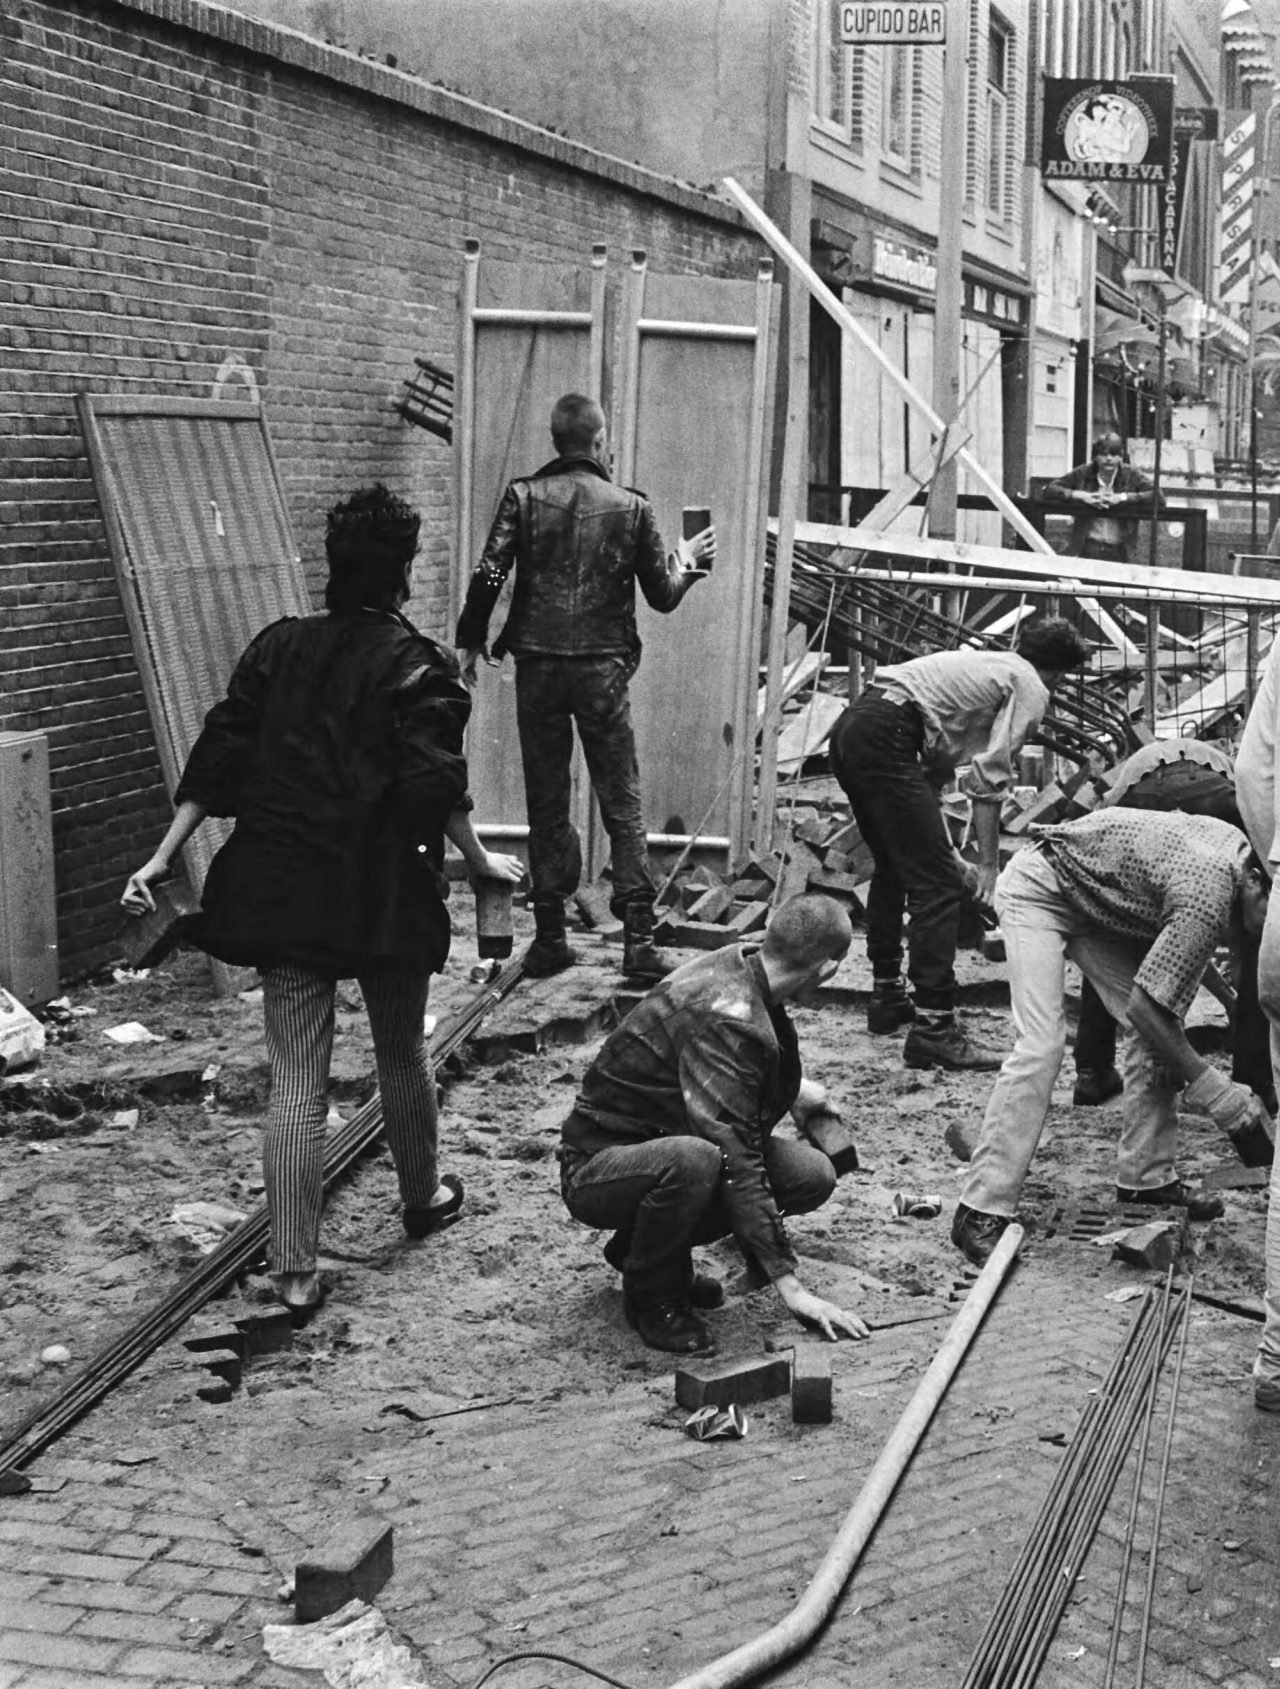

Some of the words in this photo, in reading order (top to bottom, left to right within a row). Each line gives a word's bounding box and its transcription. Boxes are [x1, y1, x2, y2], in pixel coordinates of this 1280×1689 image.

[844, 8, 904, 33] CUPIDO
[908, 8, 941, 33] BAR
[1045, 160, 1107, 178] ADAM
[1109, 165, 1124, 179] &
[1125, 164, 1166, 180] EVA
[1163, 142, 1180, 267] OPACABANA
